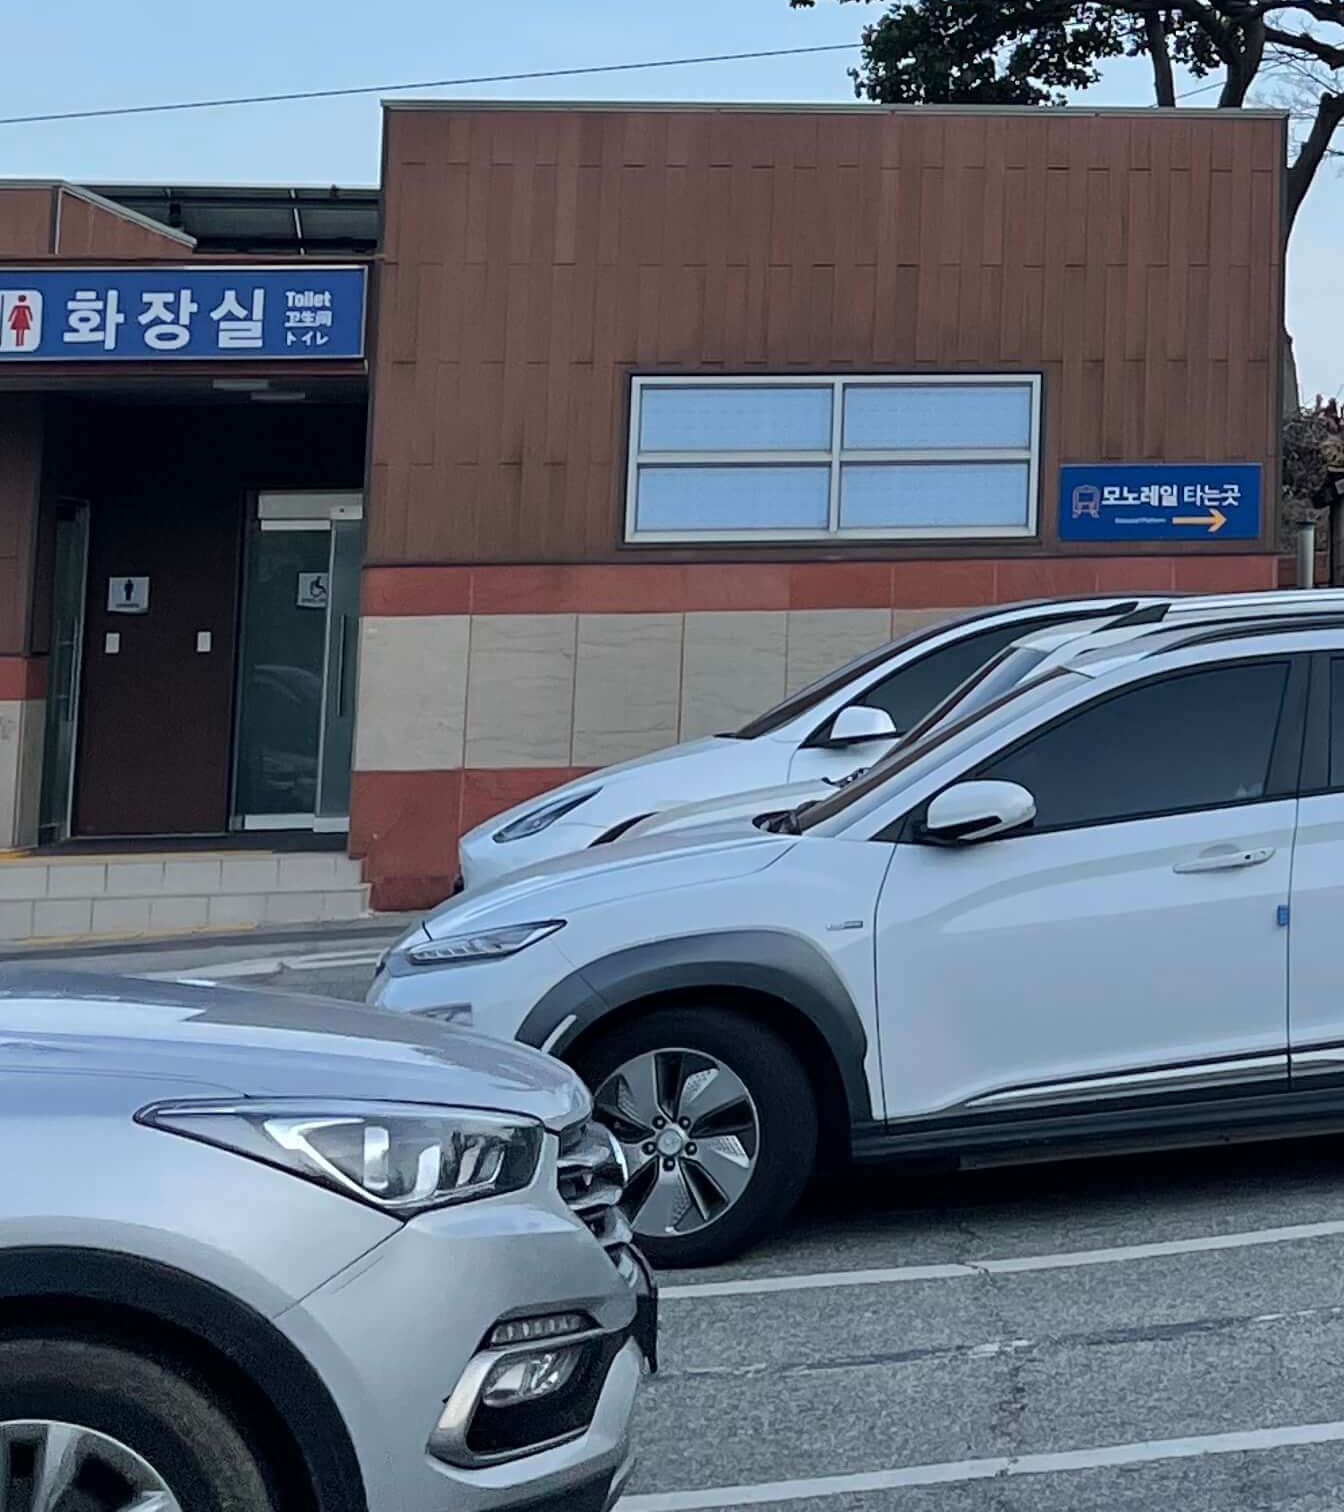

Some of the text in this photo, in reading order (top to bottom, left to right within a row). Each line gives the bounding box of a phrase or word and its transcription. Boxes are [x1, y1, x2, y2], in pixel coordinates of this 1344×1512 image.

[285, 291, 332, 308] Toilet
[63, 289, 265, 350] 화장실
[285, 331, 329, 346] トイレ
[1101, 484, 1241, 506] 모노레일 타는곳
